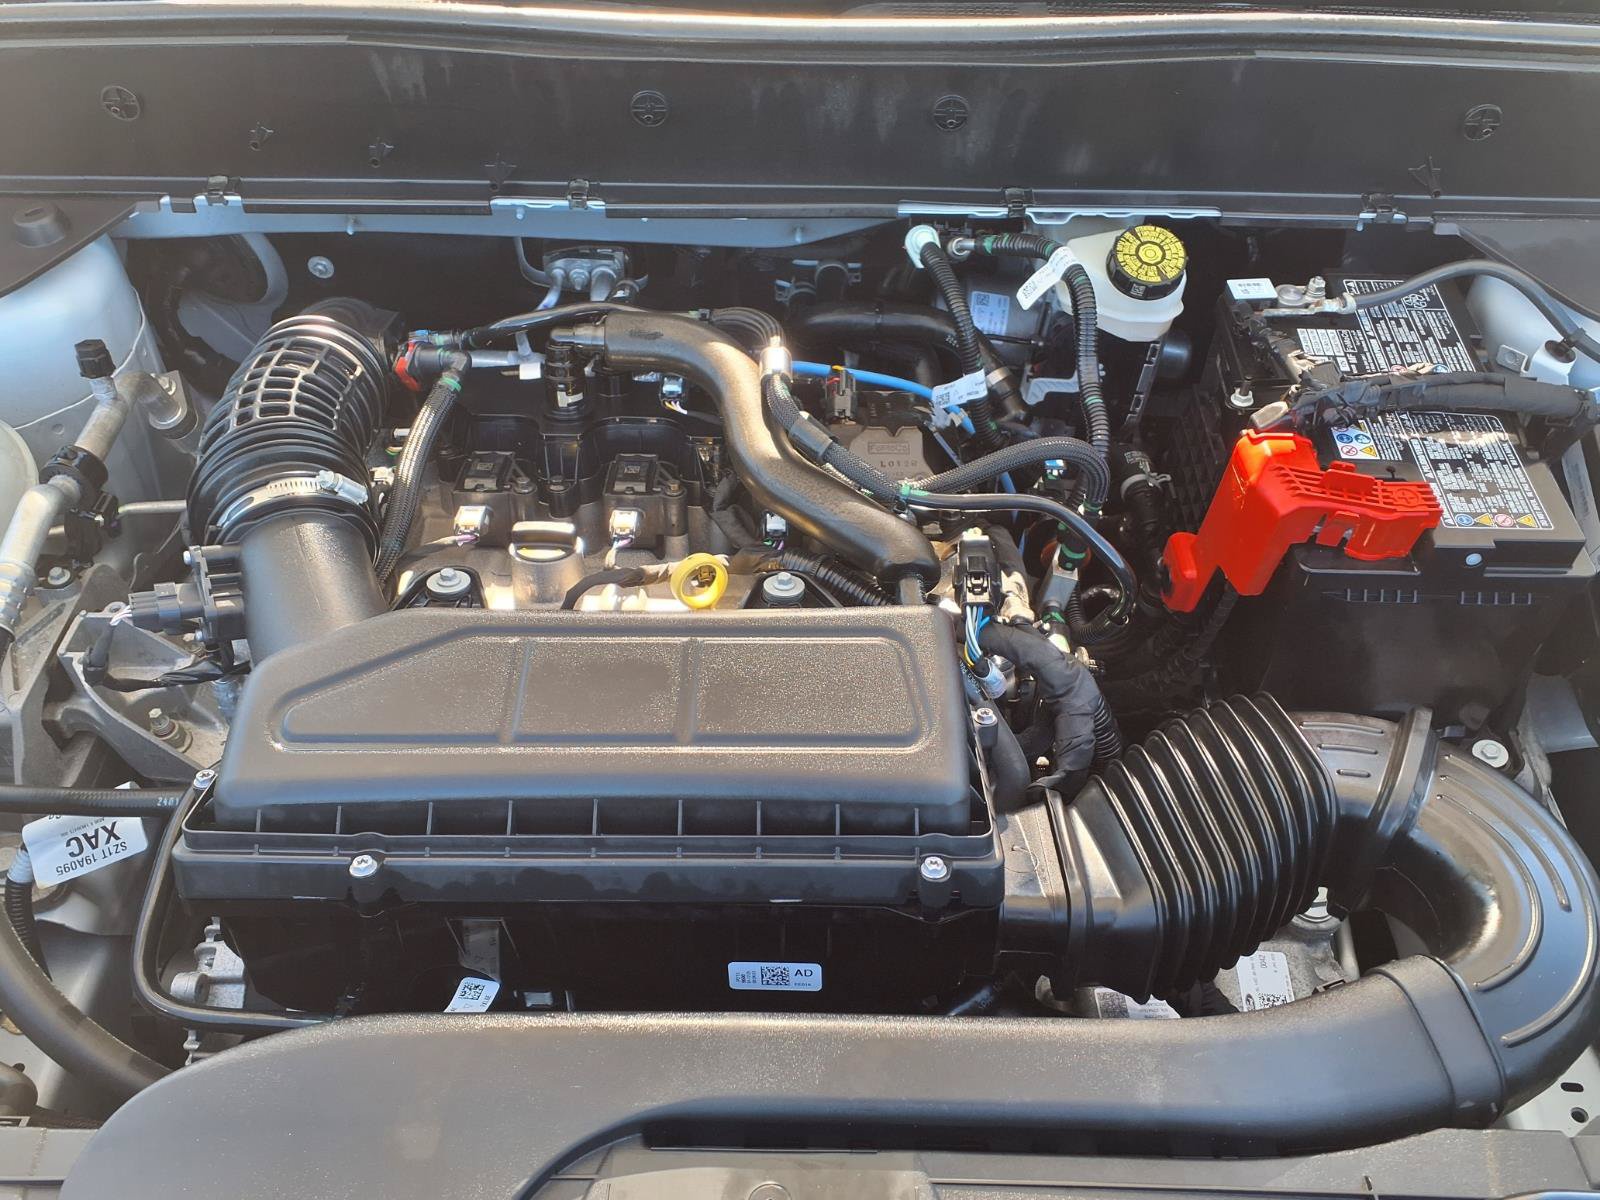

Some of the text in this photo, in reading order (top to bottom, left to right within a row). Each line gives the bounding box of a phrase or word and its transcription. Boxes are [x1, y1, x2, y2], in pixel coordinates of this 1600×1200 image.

[65, 821, 122, 858] XAC
[55, 841, 128, 876] SZ1T 19A095
[794, 969, 813, 977] AD
